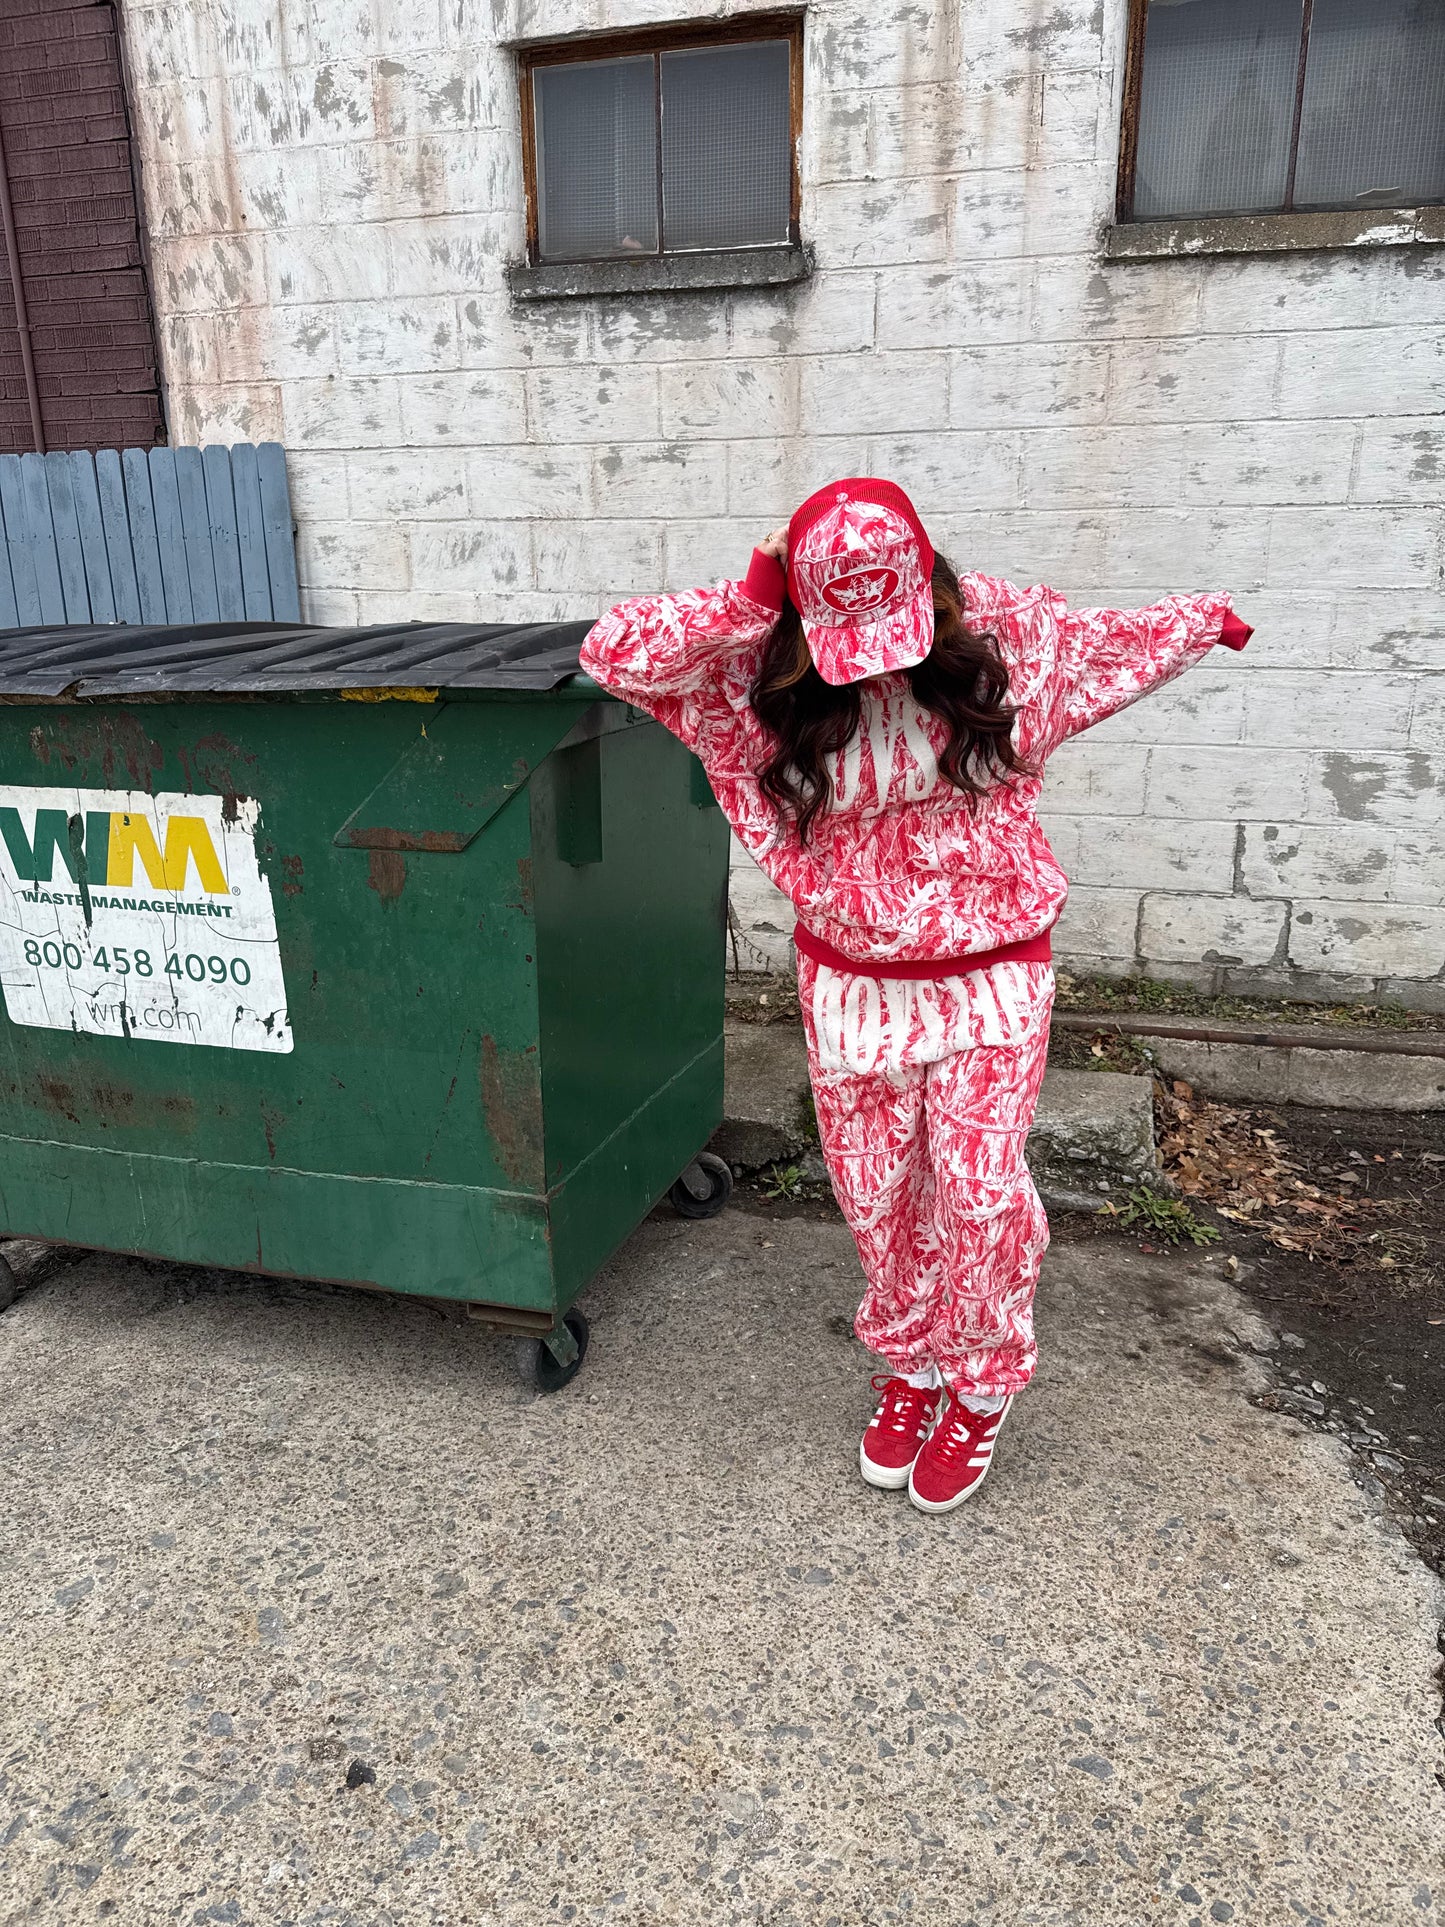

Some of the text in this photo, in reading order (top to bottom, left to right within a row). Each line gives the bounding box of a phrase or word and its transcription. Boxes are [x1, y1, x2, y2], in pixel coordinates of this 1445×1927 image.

[0, 806, 230, 894] WM
[22, 890, 233, 918] WASTE MANAGEMENT
[23, 939, 251, 986] 800 458 4090
[85, 1001, 202, 1032] wm.com
